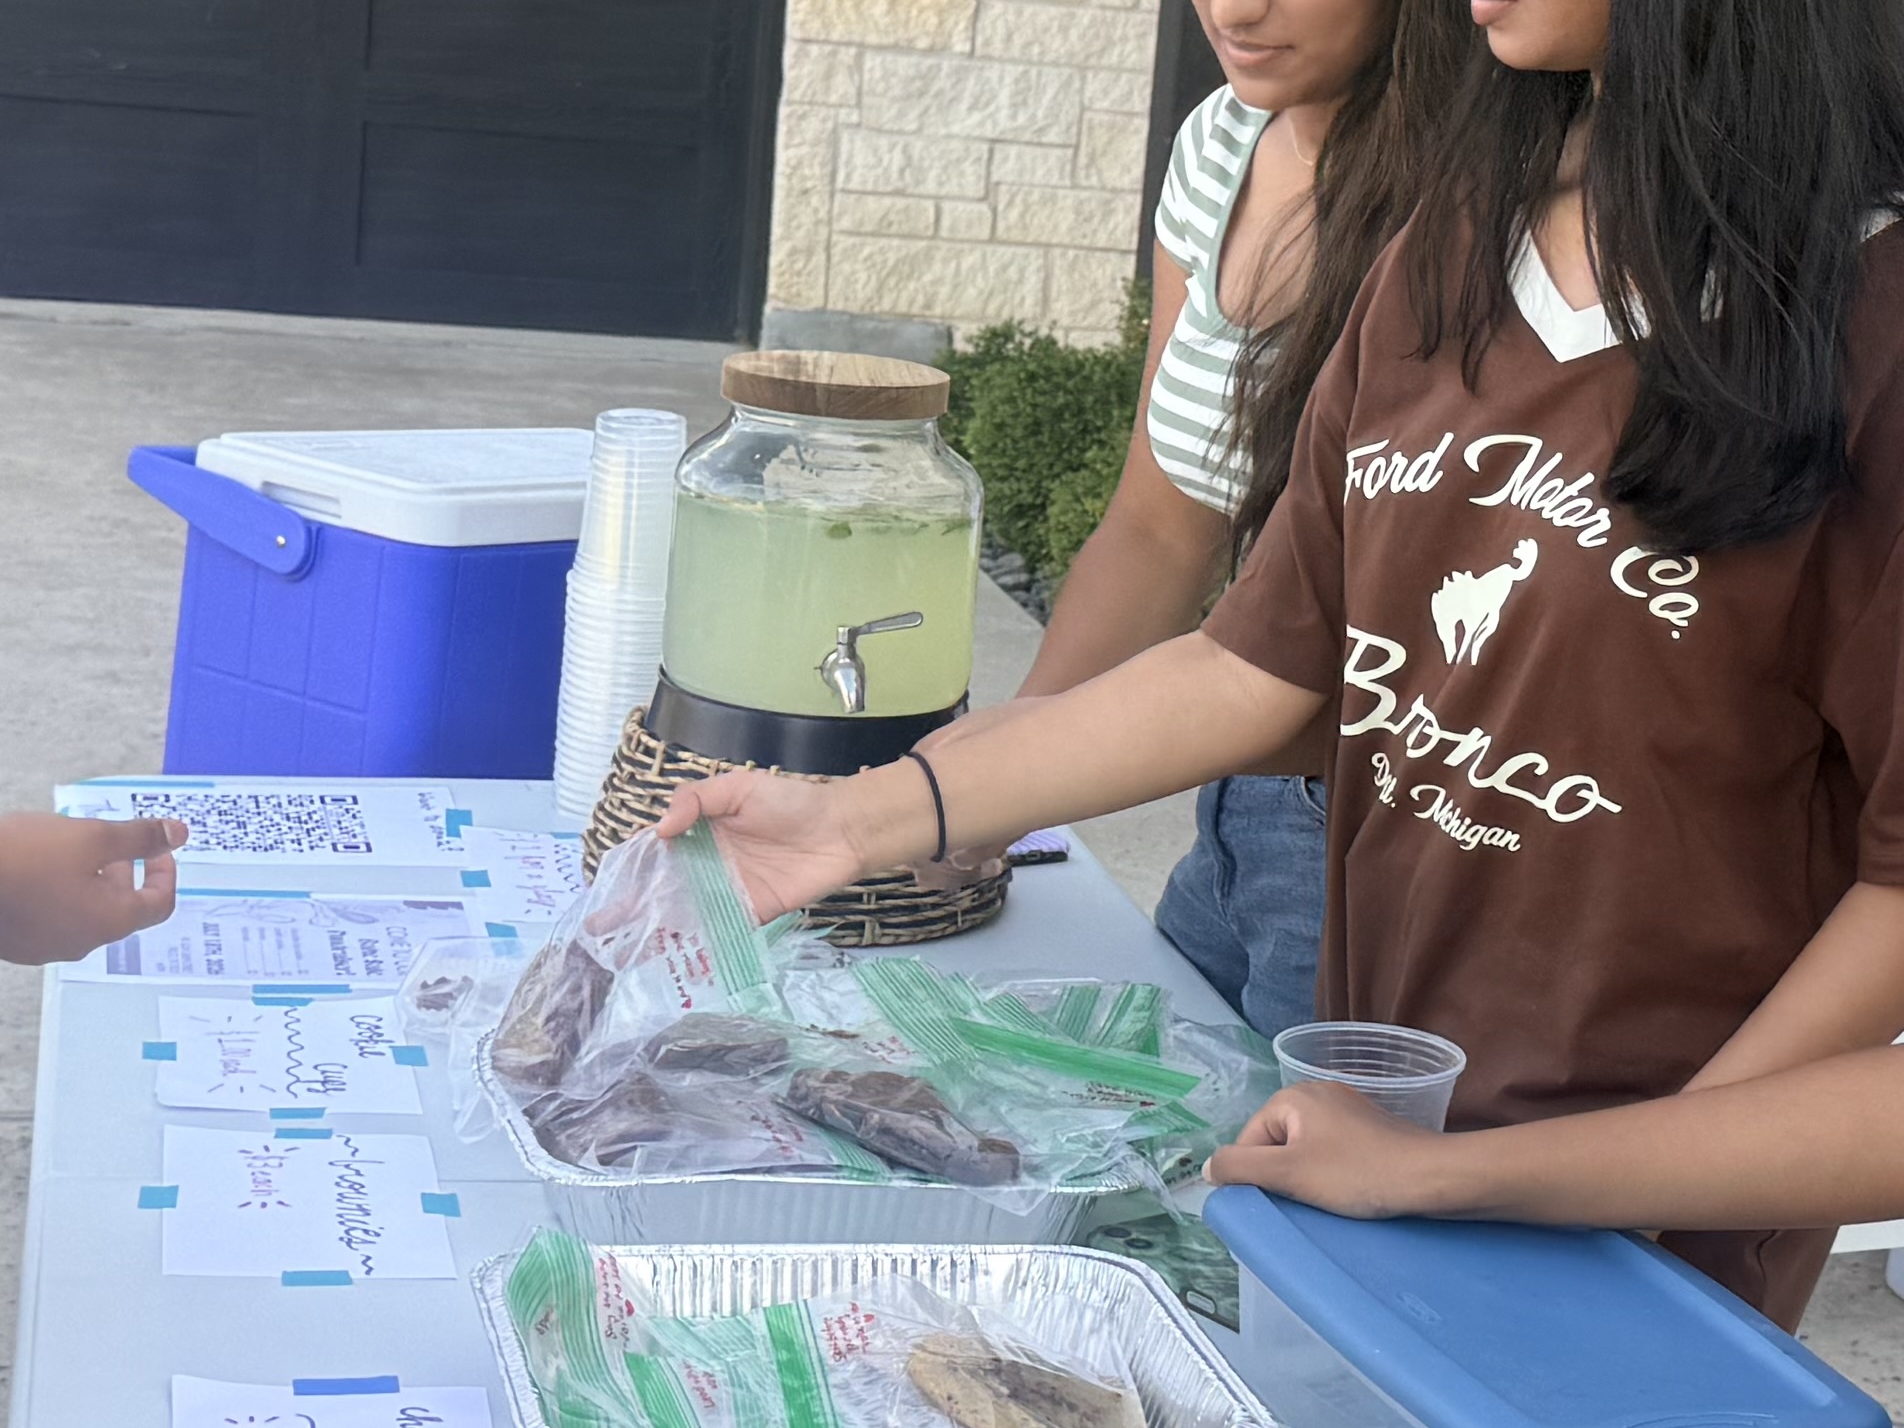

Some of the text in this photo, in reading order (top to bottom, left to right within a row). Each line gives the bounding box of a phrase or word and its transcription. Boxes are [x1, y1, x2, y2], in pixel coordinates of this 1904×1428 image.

[1344, 431, 1455, 506] Ford
[1464, 433, 1612, 548] Motor
[1340, 624, 1623, 824] Bronco
[349, 1014, 396, 1060] cookie
[248, 1171, 282, 1199] each
[327, 1159, 386, 1252] brownies
